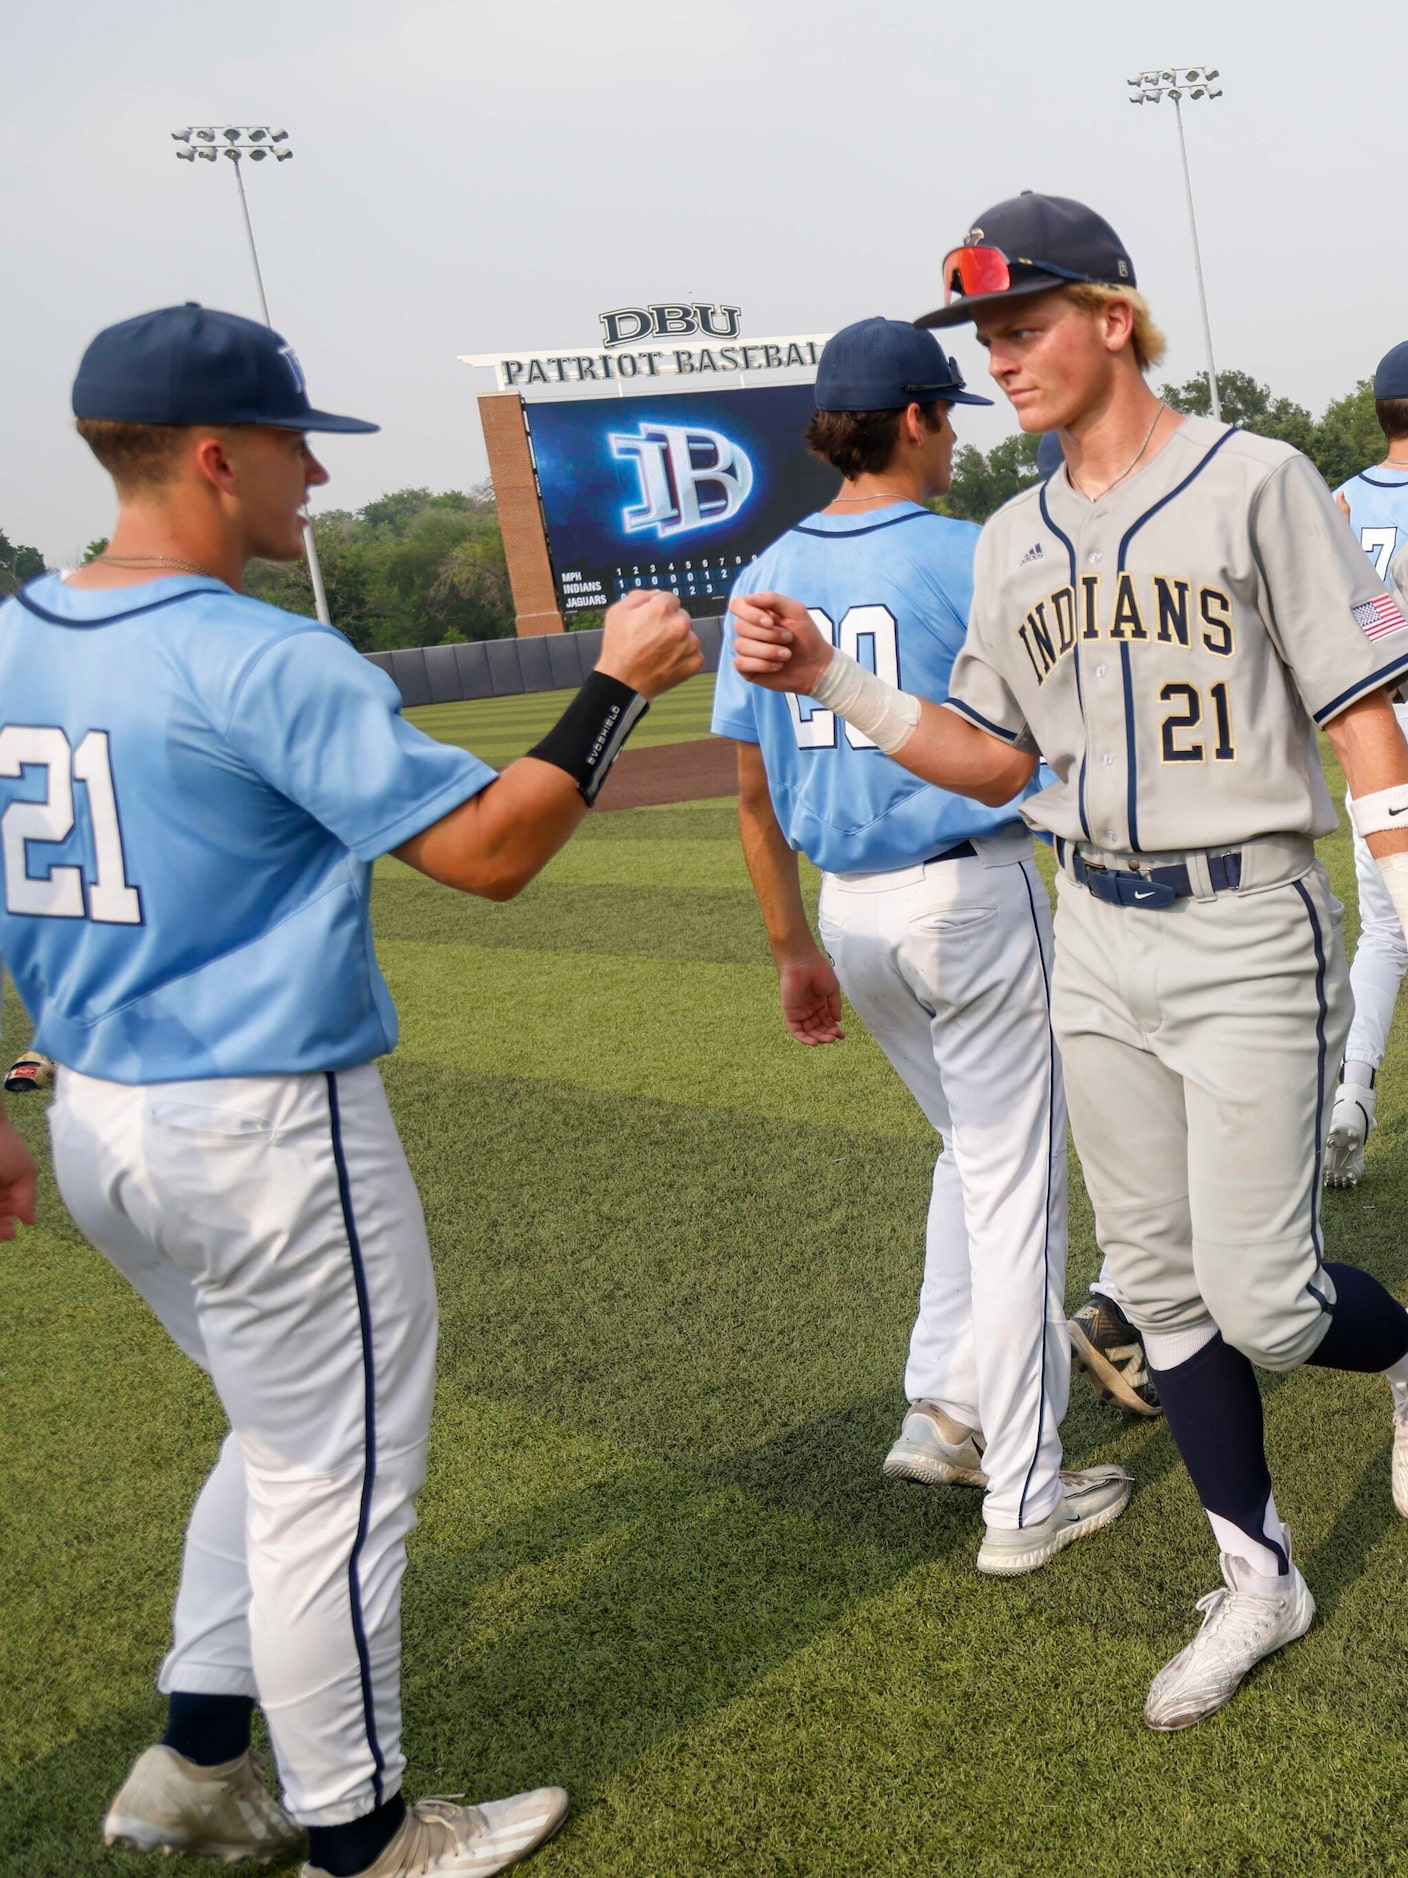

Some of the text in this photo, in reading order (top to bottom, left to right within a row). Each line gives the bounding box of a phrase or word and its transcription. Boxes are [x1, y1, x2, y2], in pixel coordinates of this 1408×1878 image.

[599, 302, 741, 347] DBU
[502, 341, 820, 385] PATRIOT BASEBAL
[561, 571, 582, 583] MPH
[617, 568, 622, 576] 1
[633, 566, 639, 575] 2
[650, 564, 656, 573] 3
[668, 562, 674, 571] 4
[702, 559, 708, 568] 6
[719, 558, 725, 566] 7
[736, 556, 742, 564] 8
[563, 570, 728, 595] INDIANS 1 0 0 0 0 1 2
[566, 594, 607, 609] JAGUARS
[689, 586, 696, 595] 2
[706, 584, 713, 593] 3
[1016, 571, 1236, 690] INDIANS
[586, 705, 621, 766] EVOSHIELD
[1157, 679, 1237, 764] 21
[0, 723, 146, 928] 21
